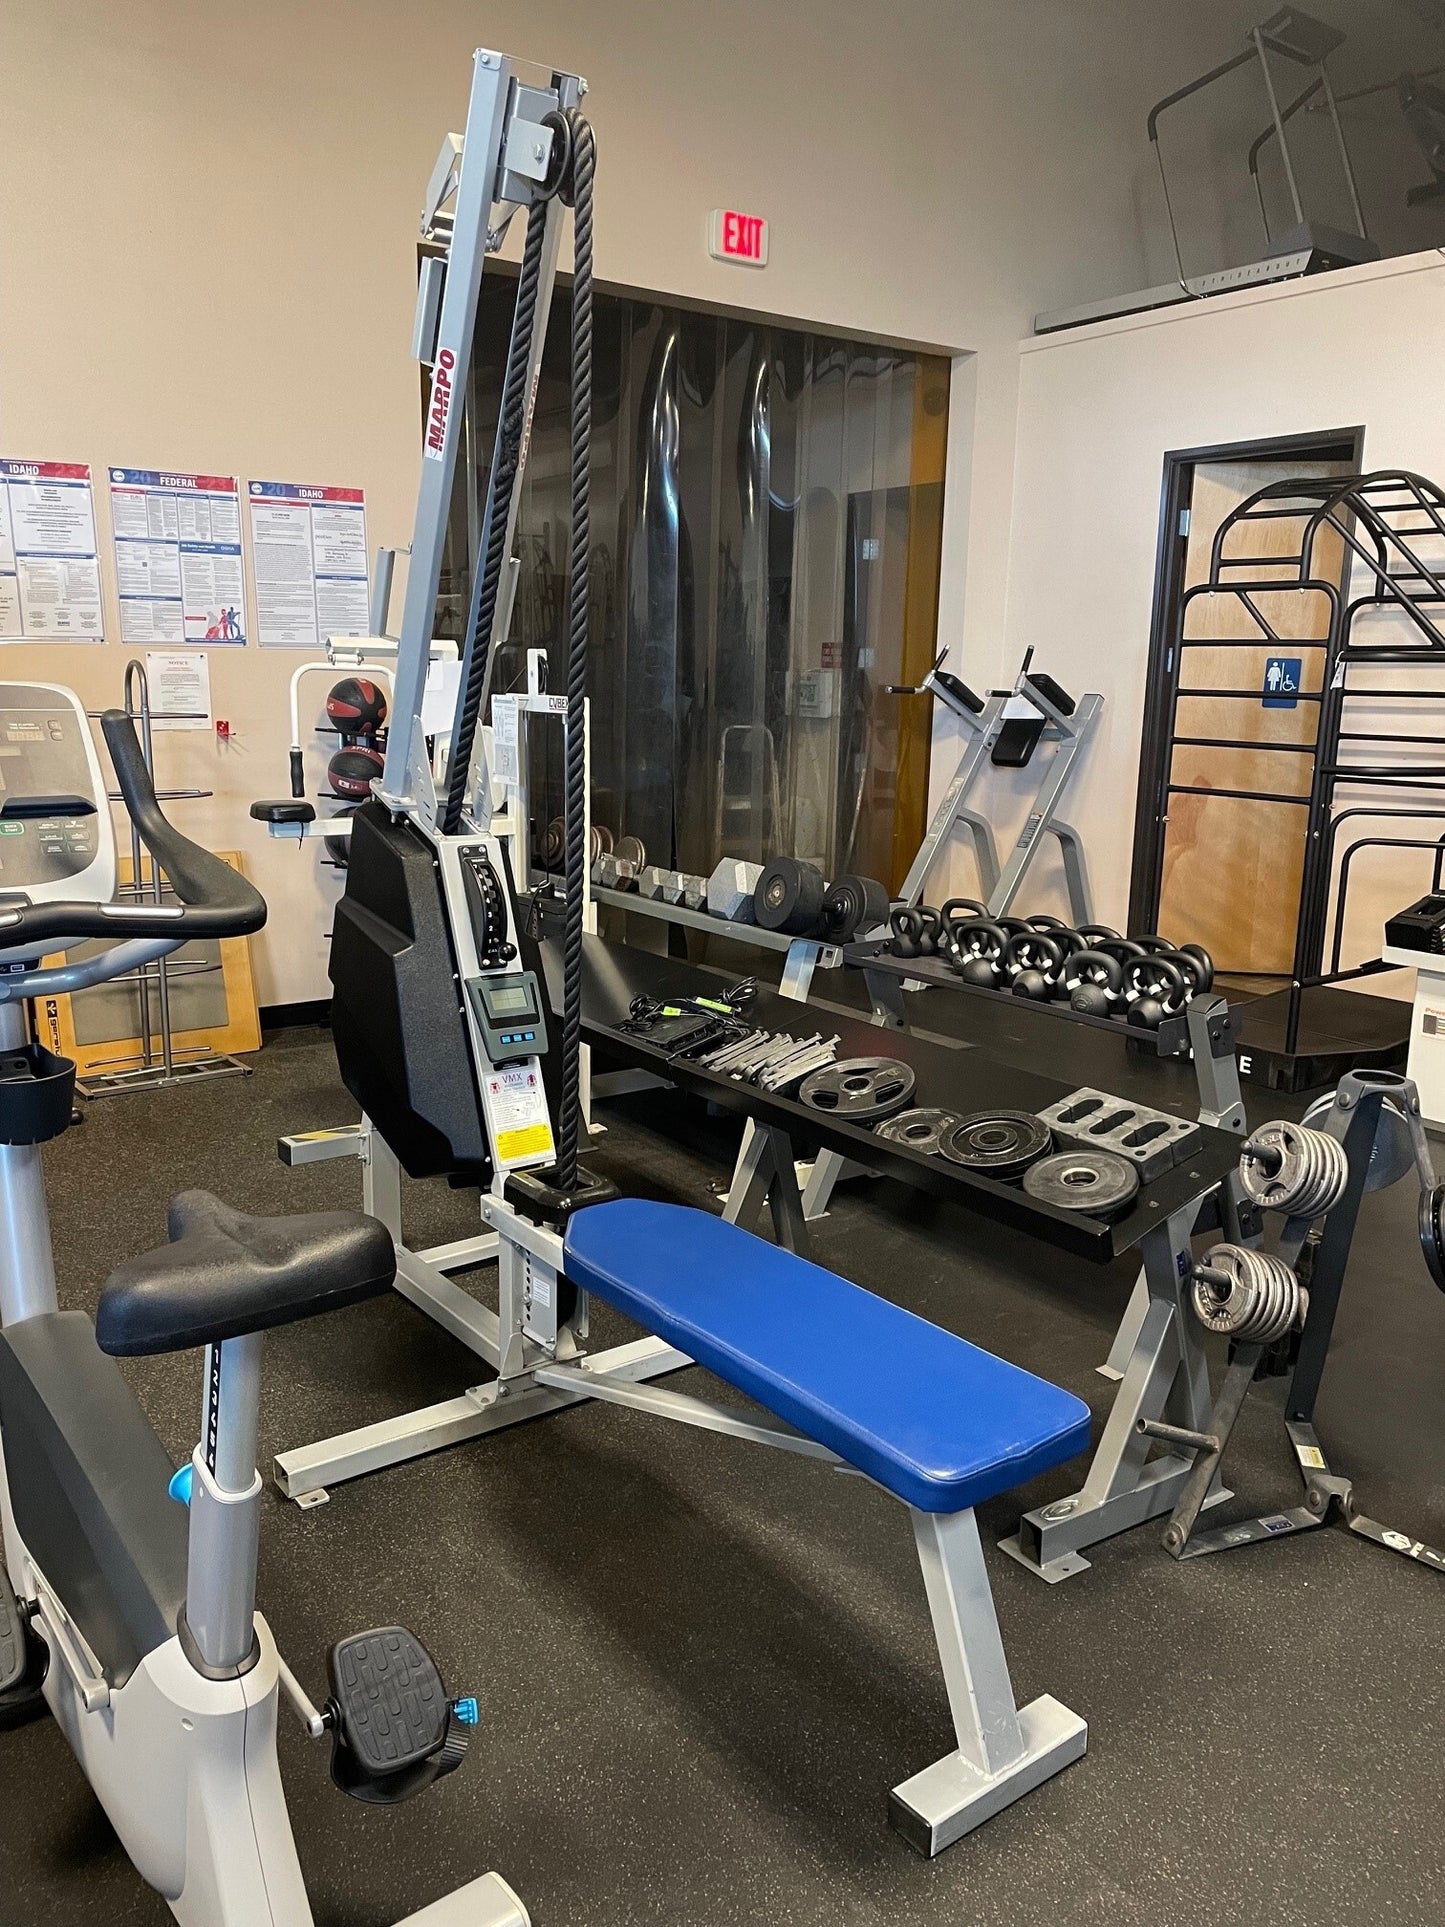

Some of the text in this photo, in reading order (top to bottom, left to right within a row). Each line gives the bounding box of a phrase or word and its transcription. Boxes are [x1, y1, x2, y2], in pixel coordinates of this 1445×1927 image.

[724, 211, 763, 258] EXIT
[428, 349, 455, 451] MARPO
[9, 464, 40, 475] IDAHO
[129, 470, 151, 484] 20
[160, 476, 198, 488] FEDERAL
[266, 484, 286, 496] 20
[298, 489, 324, 499] IDAHO
[501, 1072, 523, 1084] VMX
[214, 1349, 219, 1364] 1
[212, 1369, 219, 1387] 2
[211, 1390, 218, 1406] 3
[210, 1412, 216, 1428] 4
[209, 1431, 216, 1448] 5
[208, 1453, 214, 1468] 6
